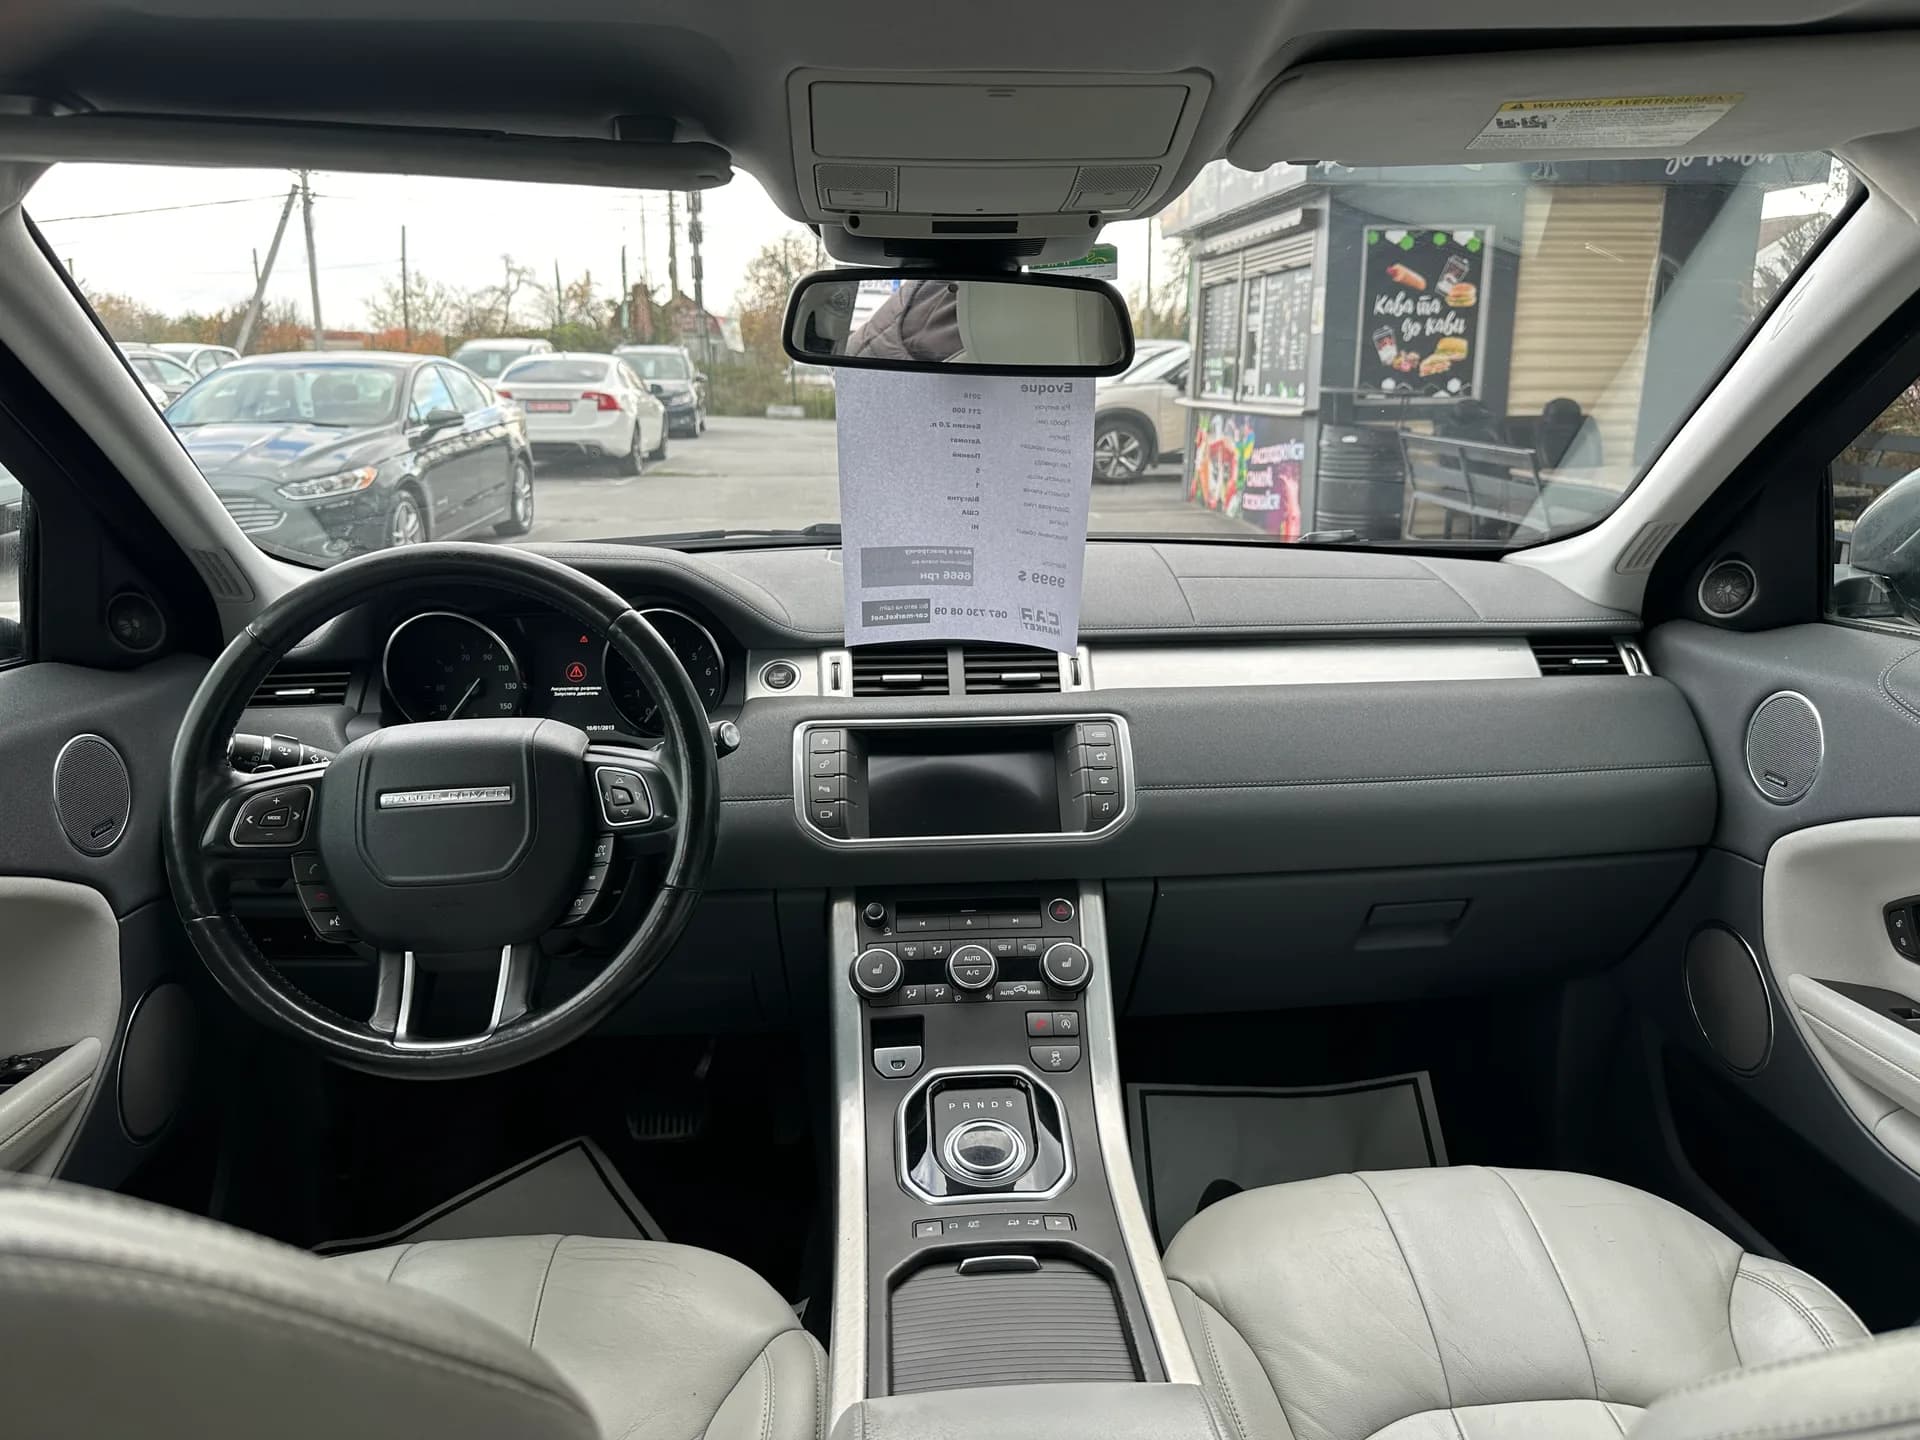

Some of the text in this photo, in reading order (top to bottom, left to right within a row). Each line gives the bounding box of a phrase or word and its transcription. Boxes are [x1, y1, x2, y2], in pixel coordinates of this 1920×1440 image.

[1532, 100, 1601, 109] WARNING
[1373, 291, 1442, 317] Кава та
[1401, 311, 1466, 342] до кави
[498, 664, 510, 672] 110
[705, 667, 712, 676] 6
[504, 682, 517, 690] 130
[709, 688, 715, 697] 7
[500, 702, 513, 711] 150
[384, 788, 509, 805] RANGE ROVER
[964, 954, 981, 962] AUTO
[966, 969, 980, 977] A/C
[1000, 989, 1015, 997] AUTO
[1027, 988, 1041, 996] MAN
